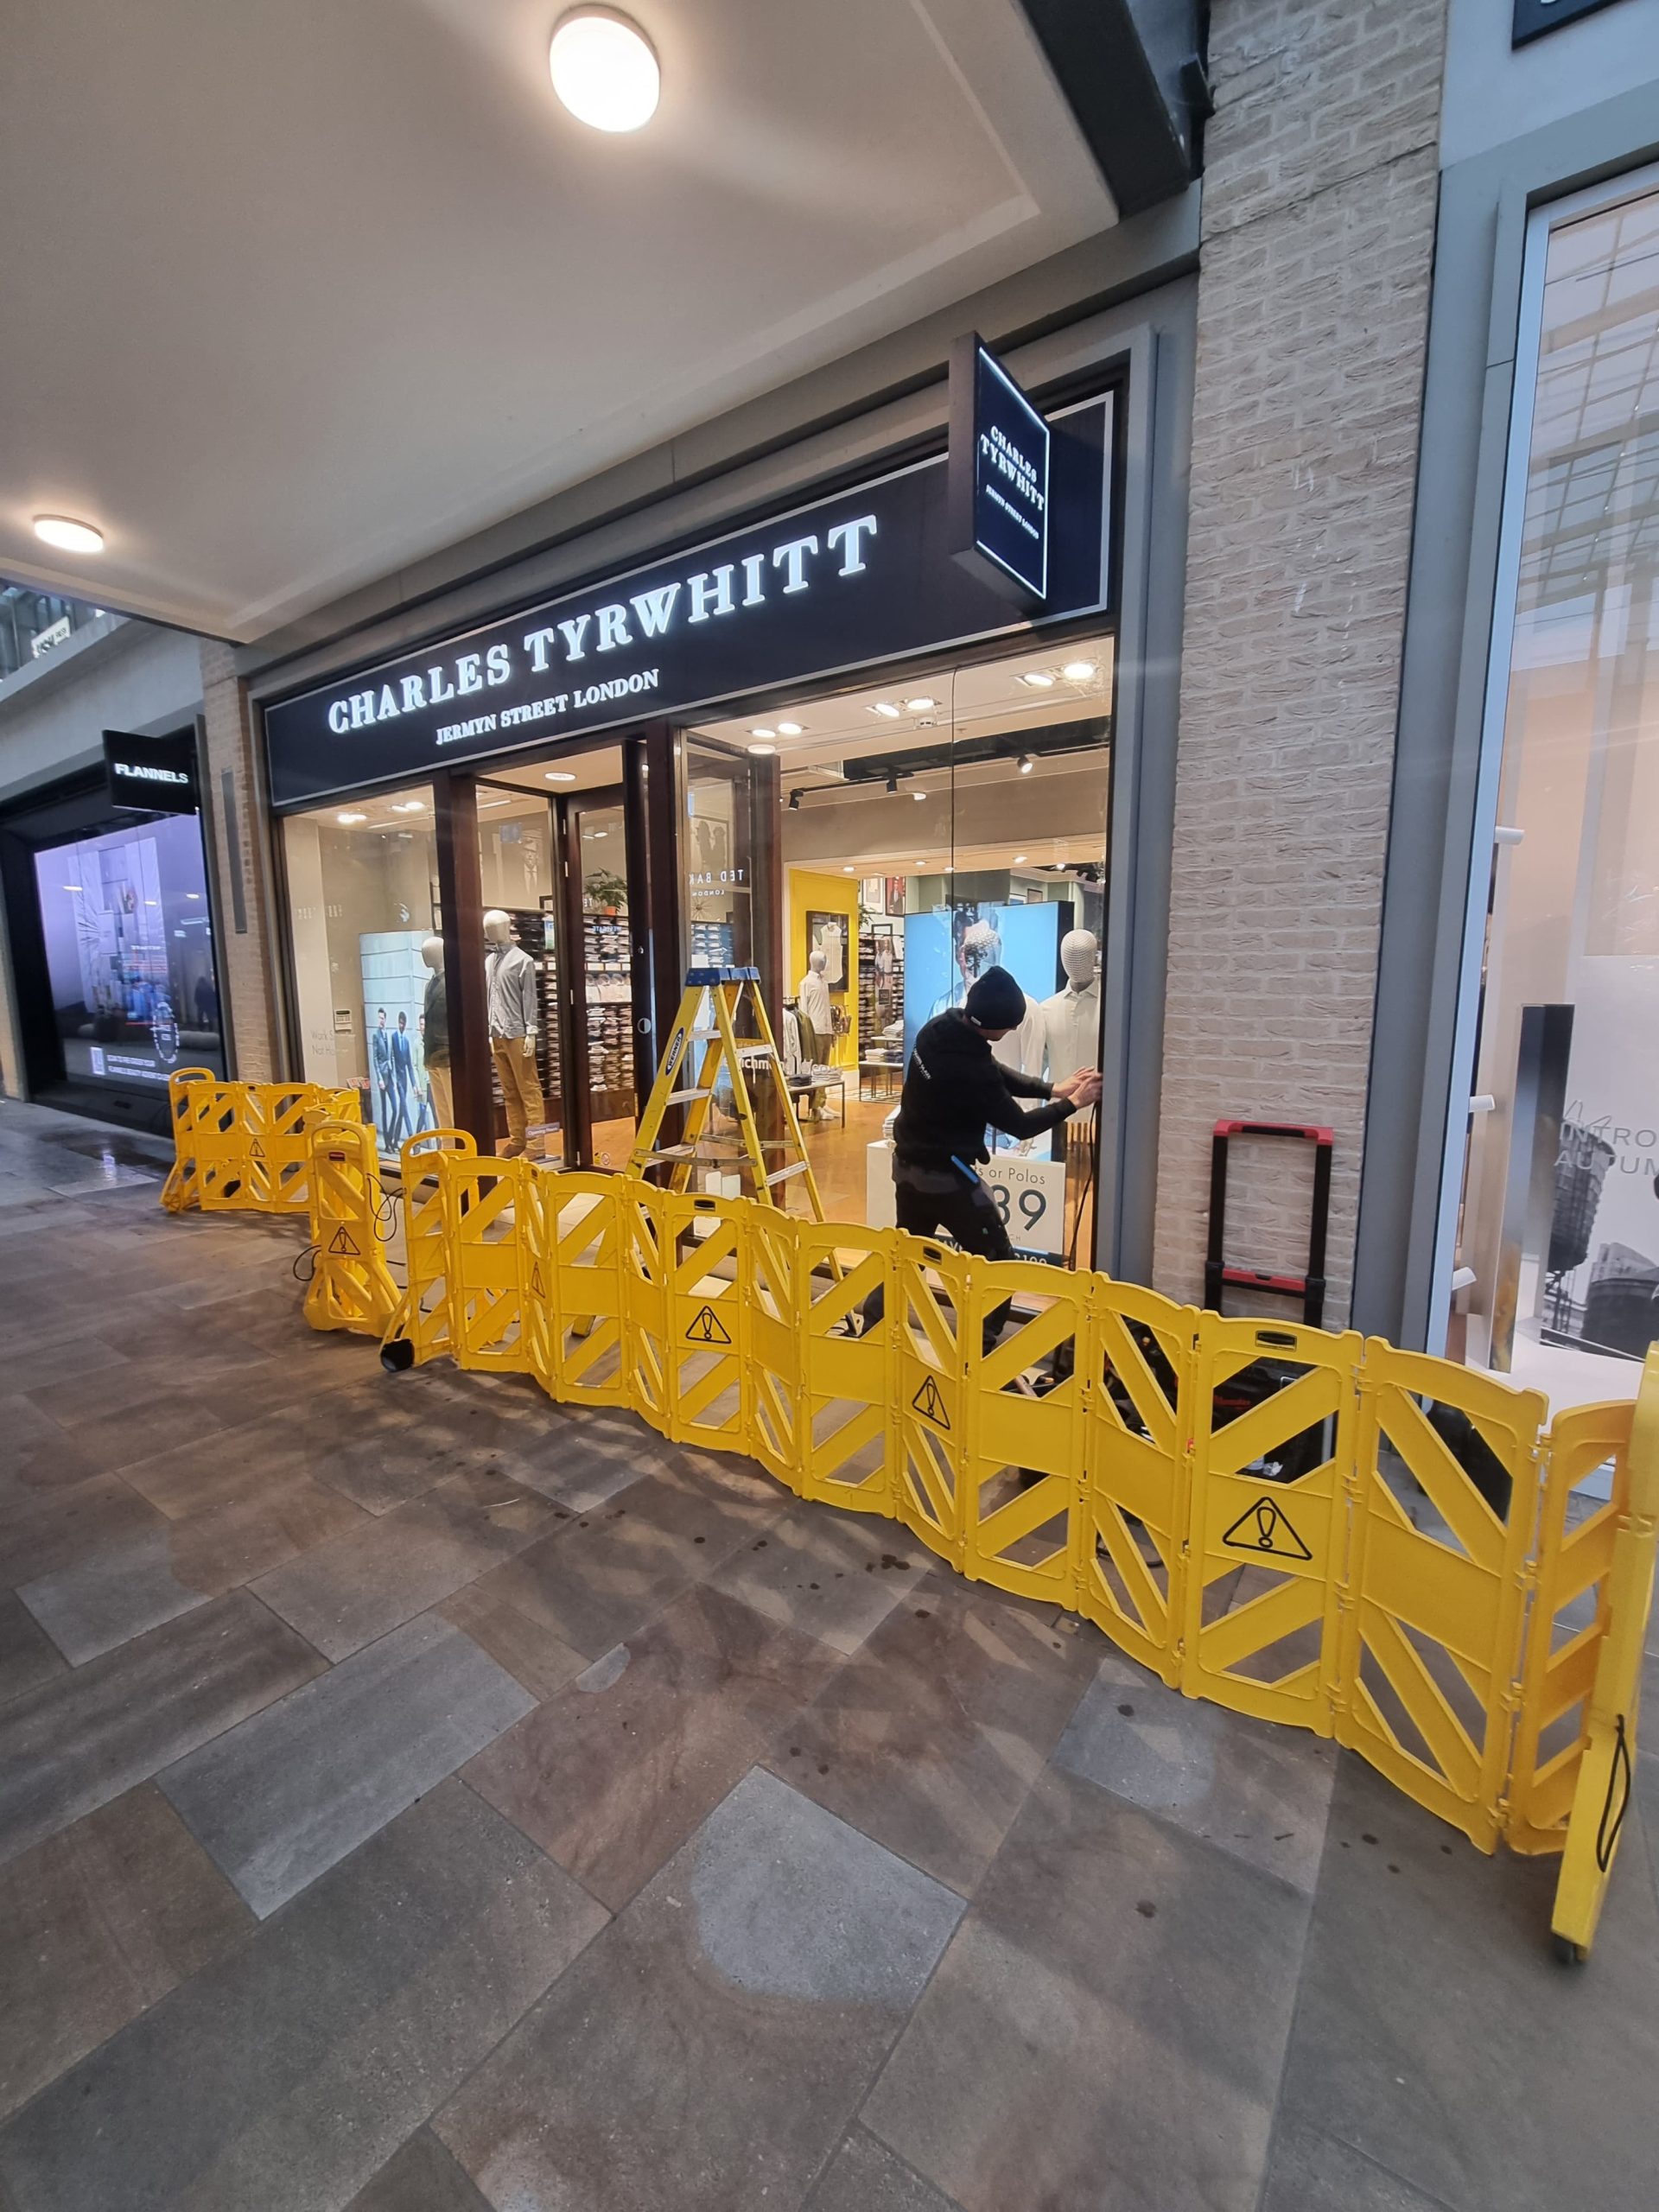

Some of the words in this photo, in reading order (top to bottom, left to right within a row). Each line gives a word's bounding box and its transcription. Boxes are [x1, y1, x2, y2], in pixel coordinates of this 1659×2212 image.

[981, 434, 1045, 511] TYRWHITT
[990, 425, 1037, 483] CHARLES
[327, 644, 512, 734] CHARLES
[524, 515, 877, 672] TYRWHITT
[435, 714, 497, 746] JERMYN
[501, 694, 569, 728] STREET
[574, 668, 660, 709] LONDON
[114, 763, 188, 784] FLANNELS
[667, 1035, 682, 1066] WERNER
[988, 1169, 1002, 1179] or
[1008, 1167, 1046, 1185] Polos
